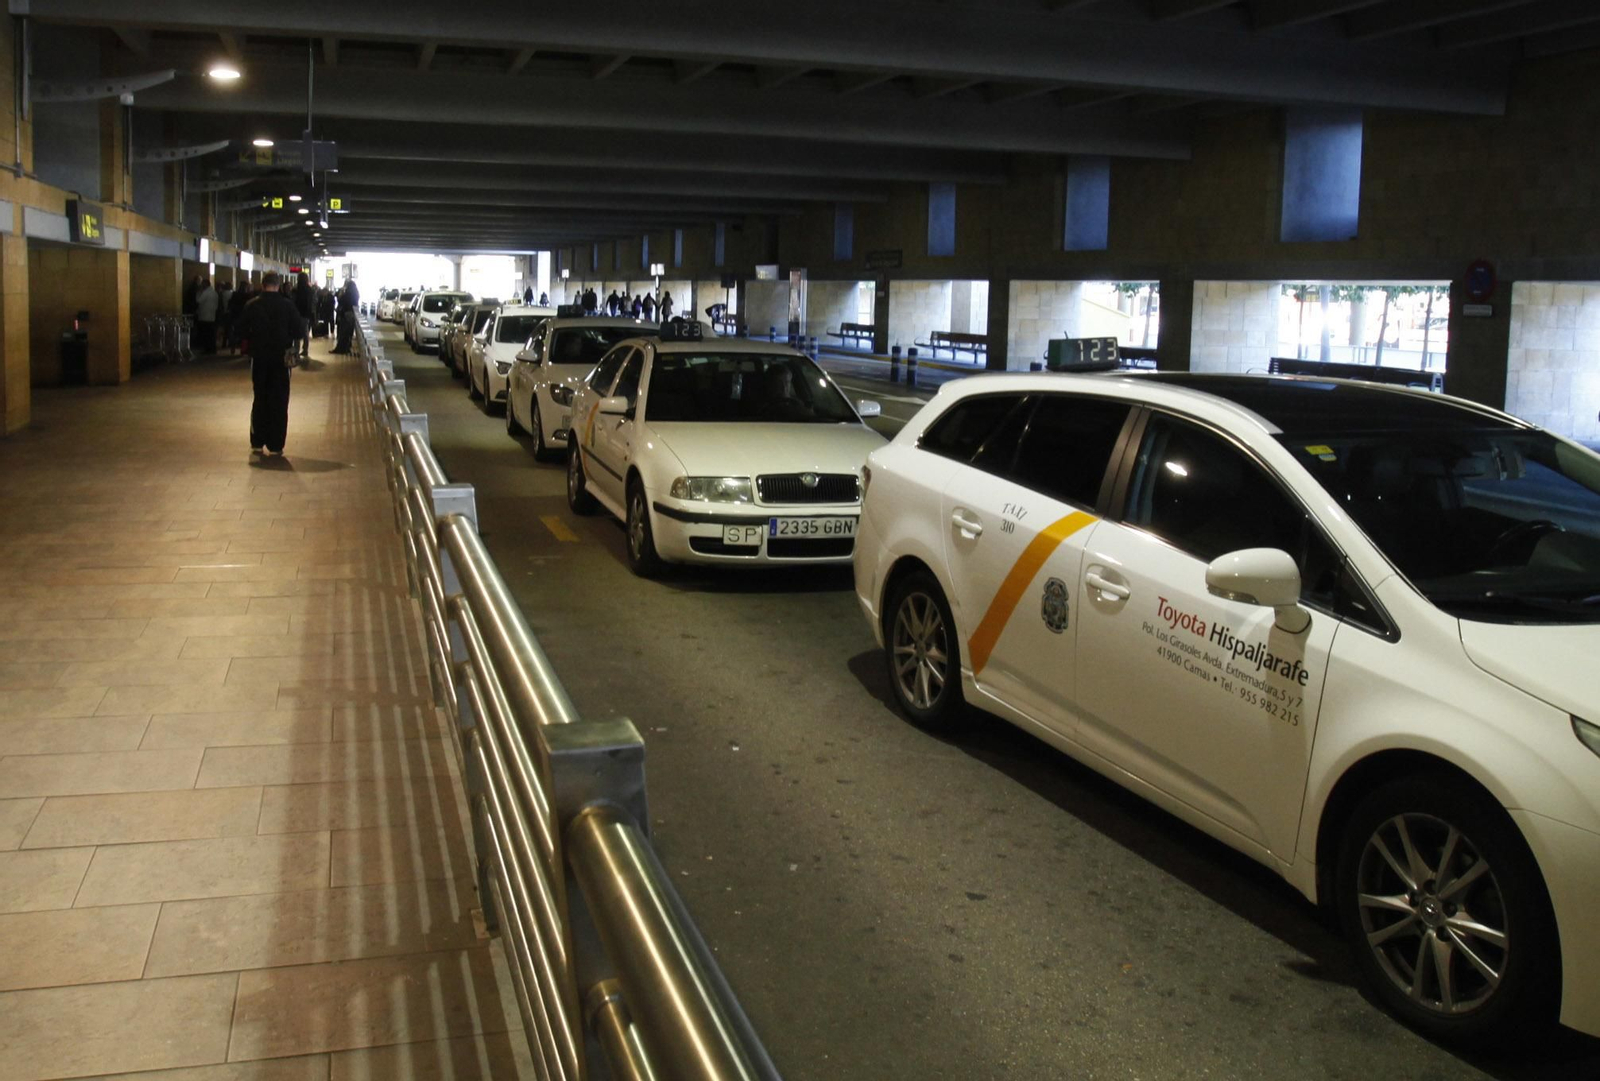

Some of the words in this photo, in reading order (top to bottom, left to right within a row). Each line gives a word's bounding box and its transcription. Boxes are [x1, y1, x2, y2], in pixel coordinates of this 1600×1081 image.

[674, 322, 701, 337] 123
[1077, 338, 1117, 362] 123
[727, 527, 757, 543] SP
[779, 519, 819, 535] 2335
[823, 519, 853, 535] GBN
[1142, 621, 1155, 637] Pol.
[1156, 628, 1169, 643] Los
[1169, 635, 1203, 660] Girasoles
[1157, 596, 1207, 638] Toyota
[1209, 622, 1310, 687] Hispaljarafe
[1156, 646, 1183, 667] 41900
[1183, 658, 1212, 683] Camas
[1239, 687, 1258, 706] 955
[1259, 698, 1279, 717] 982
[1280, 708, 1300, 727] 215
